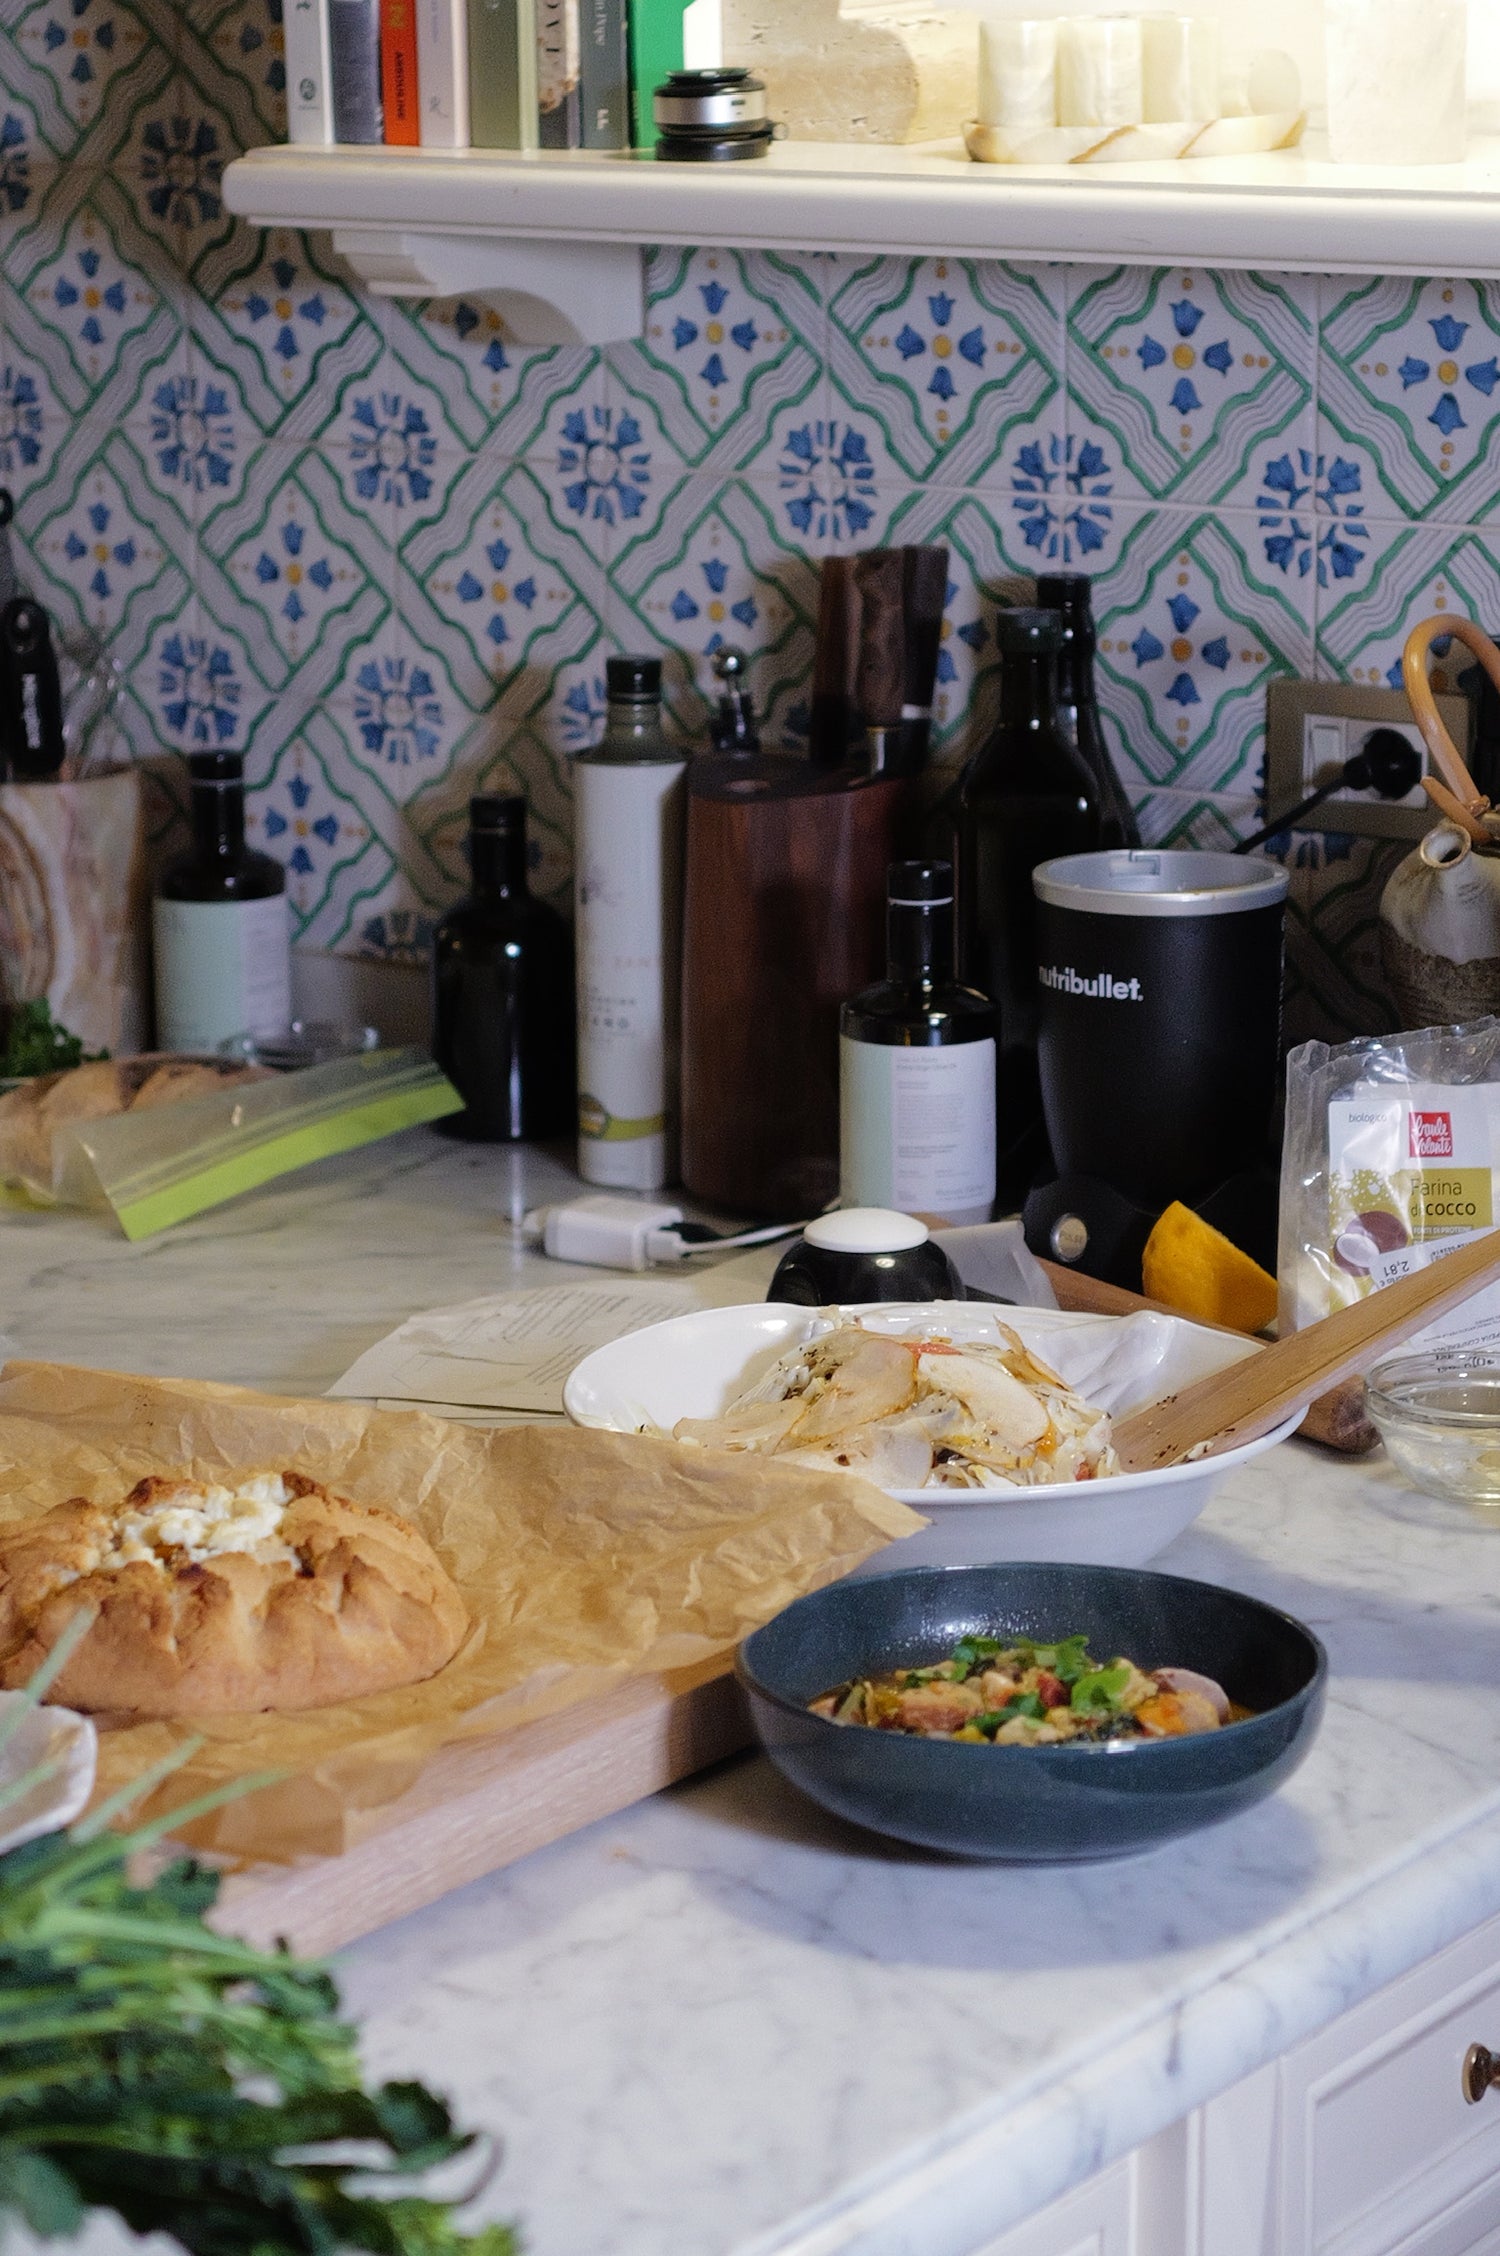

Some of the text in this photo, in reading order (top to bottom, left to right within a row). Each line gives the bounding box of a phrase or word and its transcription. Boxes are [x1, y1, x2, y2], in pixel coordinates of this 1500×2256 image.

[1410, 1178, 1462, 1196] Farina
[1426, 1202, 1477, 1216] cocco
[1383, 1261, 1410, 1277] 2,81
